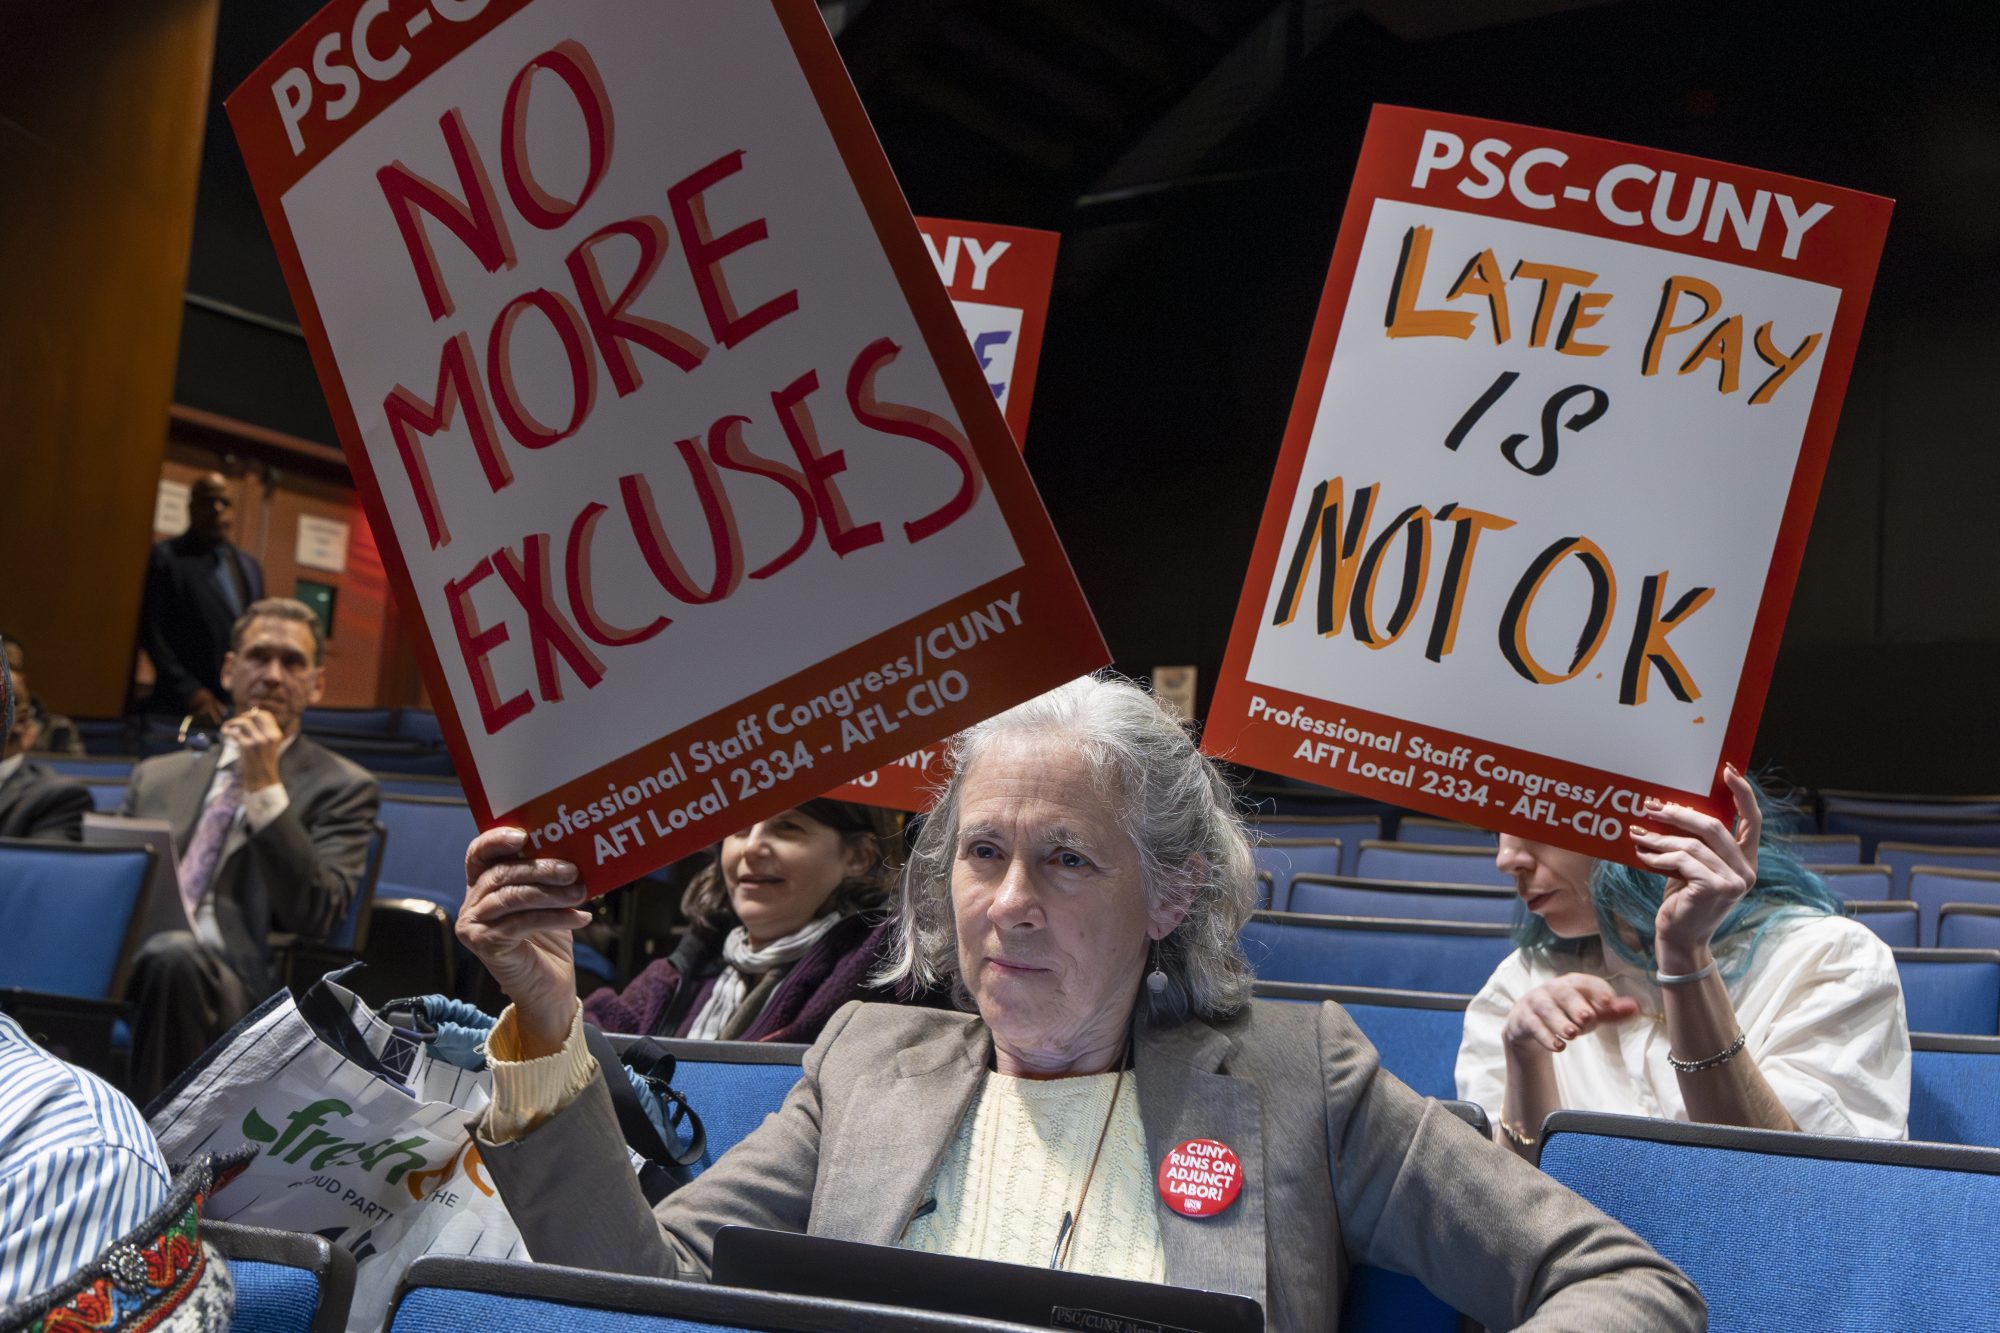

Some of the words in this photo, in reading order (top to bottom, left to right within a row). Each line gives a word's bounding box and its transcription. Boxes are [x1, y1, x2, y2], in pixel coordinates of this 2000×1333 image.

[376, 38, 614, 323] NO
[1411, 129, 1834, 260] PSC-CUNY
[383, 149, 799, 551] MORE
[1384, 224, 1614, 357] LATE
[1641, 275, 1823, 406] PAY
[1444, 371, 1610, 476] IS
[443, 336, 984, 735] EXCUSES
[1272, 476, 1518, 663] NOT
[529, 752, 687, 849] rofessional
[689, 714, 764, 773] Staff
[766, 590, 1023, 735] Congress/CUNY
[593, 816, 645, 865] AFT
[647, 778, 729, 837] Local
[730, 741, 814, 800] 2334
[840, 670, 969, 752] AFL-CIO
[1248, 696, 1402, 753] Professional
[1405, 736, 1472, 771] Staff
[1474, 754, 1694, 818] Congress/CU
[1293, 739, 1345, 768] AFT
[1348, 751, 1416, 788] Local
[1419, 770, 1489, 807] 2334
[1510, 796, 1623, 841] AFL-CIO
[1166, 1167, 1233, 1189] ADJUNCT
[1169, 1181, 1223, 1201] LABOR!
[1170, 1153, 1210, 1170] RUNS
[1212, 1160, 1236, 1175] ON
[1186, 1143, 1228, 1159] CUNY
